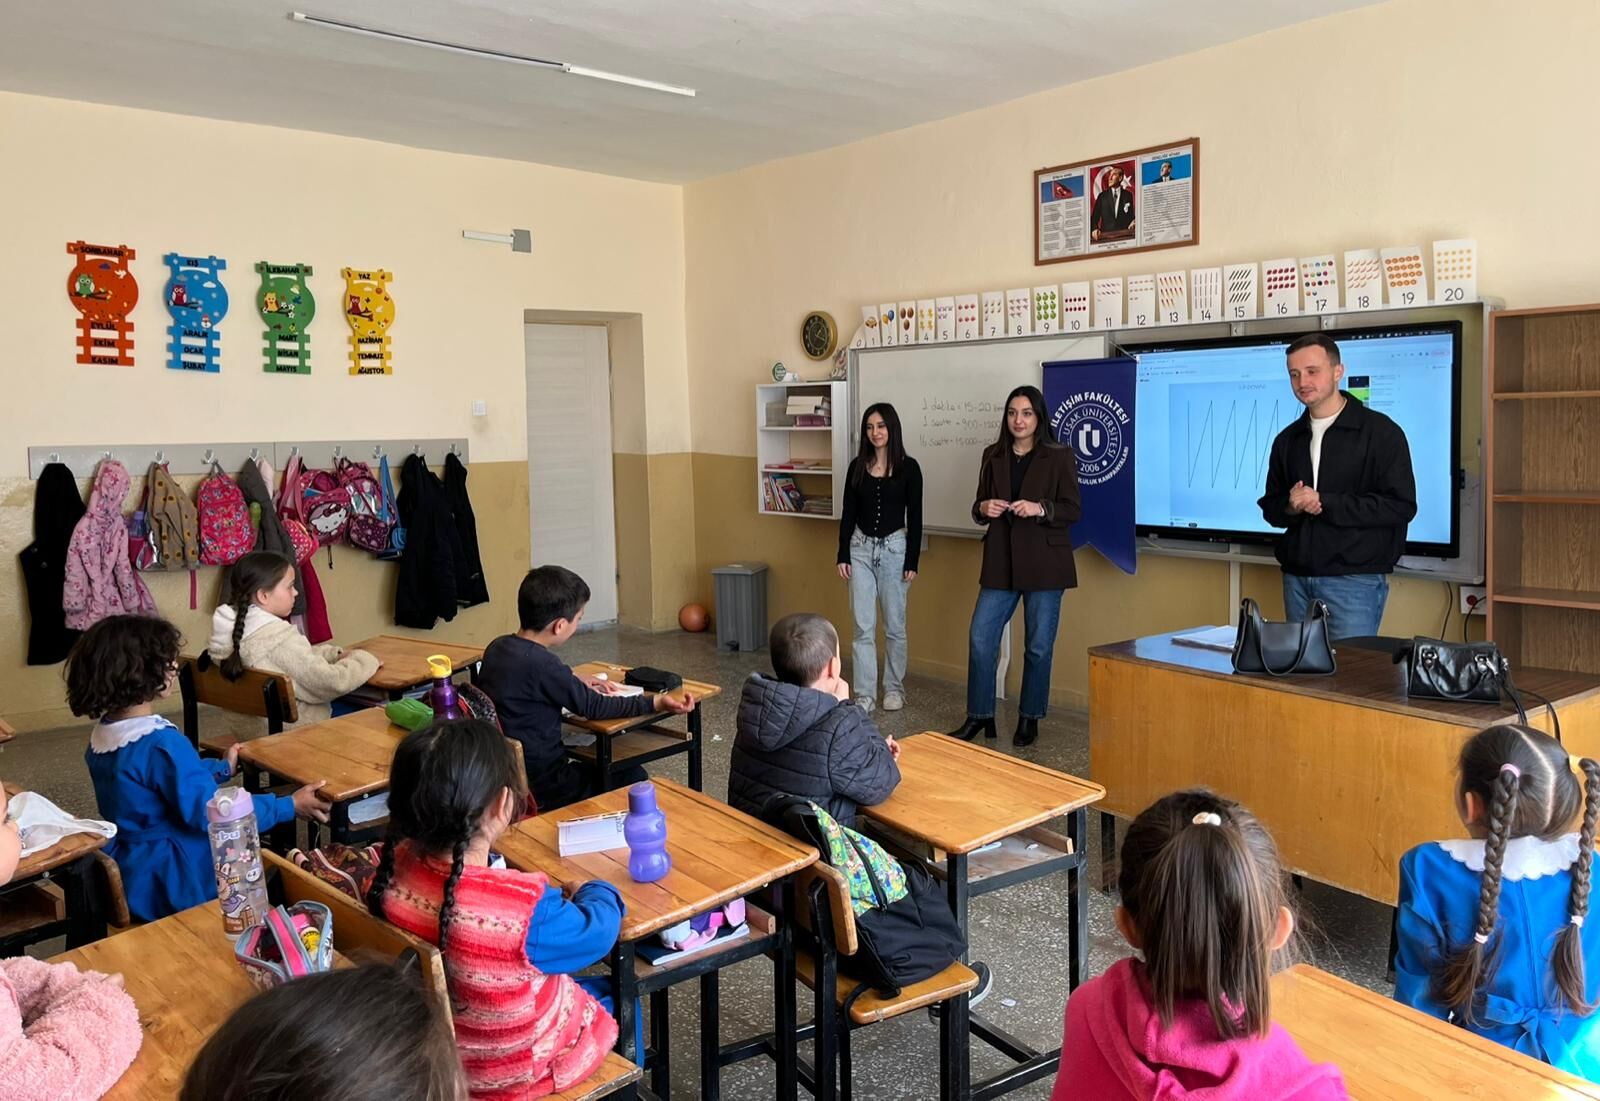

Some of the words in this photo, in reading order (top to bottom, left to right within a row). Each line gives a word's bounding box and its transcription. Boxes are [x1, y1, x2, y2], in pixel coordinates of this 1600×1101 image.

[80, 245, 124, 257] SONBAHAR
[1401, 292, 1415, 305] 19
[1444, 287, 1464, 302] 20
[1315, 299, 1328, 312] 17
[1357, 296, 1370, 308] 18
[1234, 306, 1245, 318] 15
[1276, 303, 1288, 314] 16
[1136, 314, 1146, 326] 12
[1169, 312, 1179, 323] 13
[1200, 309, 1211, 321] 14
[90, 319, 117, 331] EYLÜL
[1043, 322, 1050, 333] 9
[1071, 320, 1080, 331] 10
[1105, 317, 1112, 328] 11
[183, 329, 208, 339] ARALIK
[942, 330, 948, 340] 5
[964, 329, 971, 339] 6
[990, 326, 996, 337] 7
[1016, 325, 1023, 335] 8
[357, 336, 383, 344] HAZİRAN
[871, 337, 875, 345] 1
[887, 336, 893, 345] 2
[904, 334, 909, 343] 3
[923, 333, 929, 341] 4
[93, 338, 116, 348] EKİM
[856, 339, 862, 347] 0
[183, 346, 204, 355] OCAK
[277, 348, 299, 358] NİSAN
[91, 356, 119, 365] KASIM
[357, 352, 384, 360] TEMMUZ
[276, 365, 297, 373] MAYIS
[357, 366, 385, 375] AĞUSTOS
[1050, 393, 1083, 428] İLETİŞİM
[1084, 391, 1130, 425] FAKÜLTESİ
[1082, 407, 1118, 458] ÜNİVERSİTESİ
[1080, 463, 1100, 473] 2006
